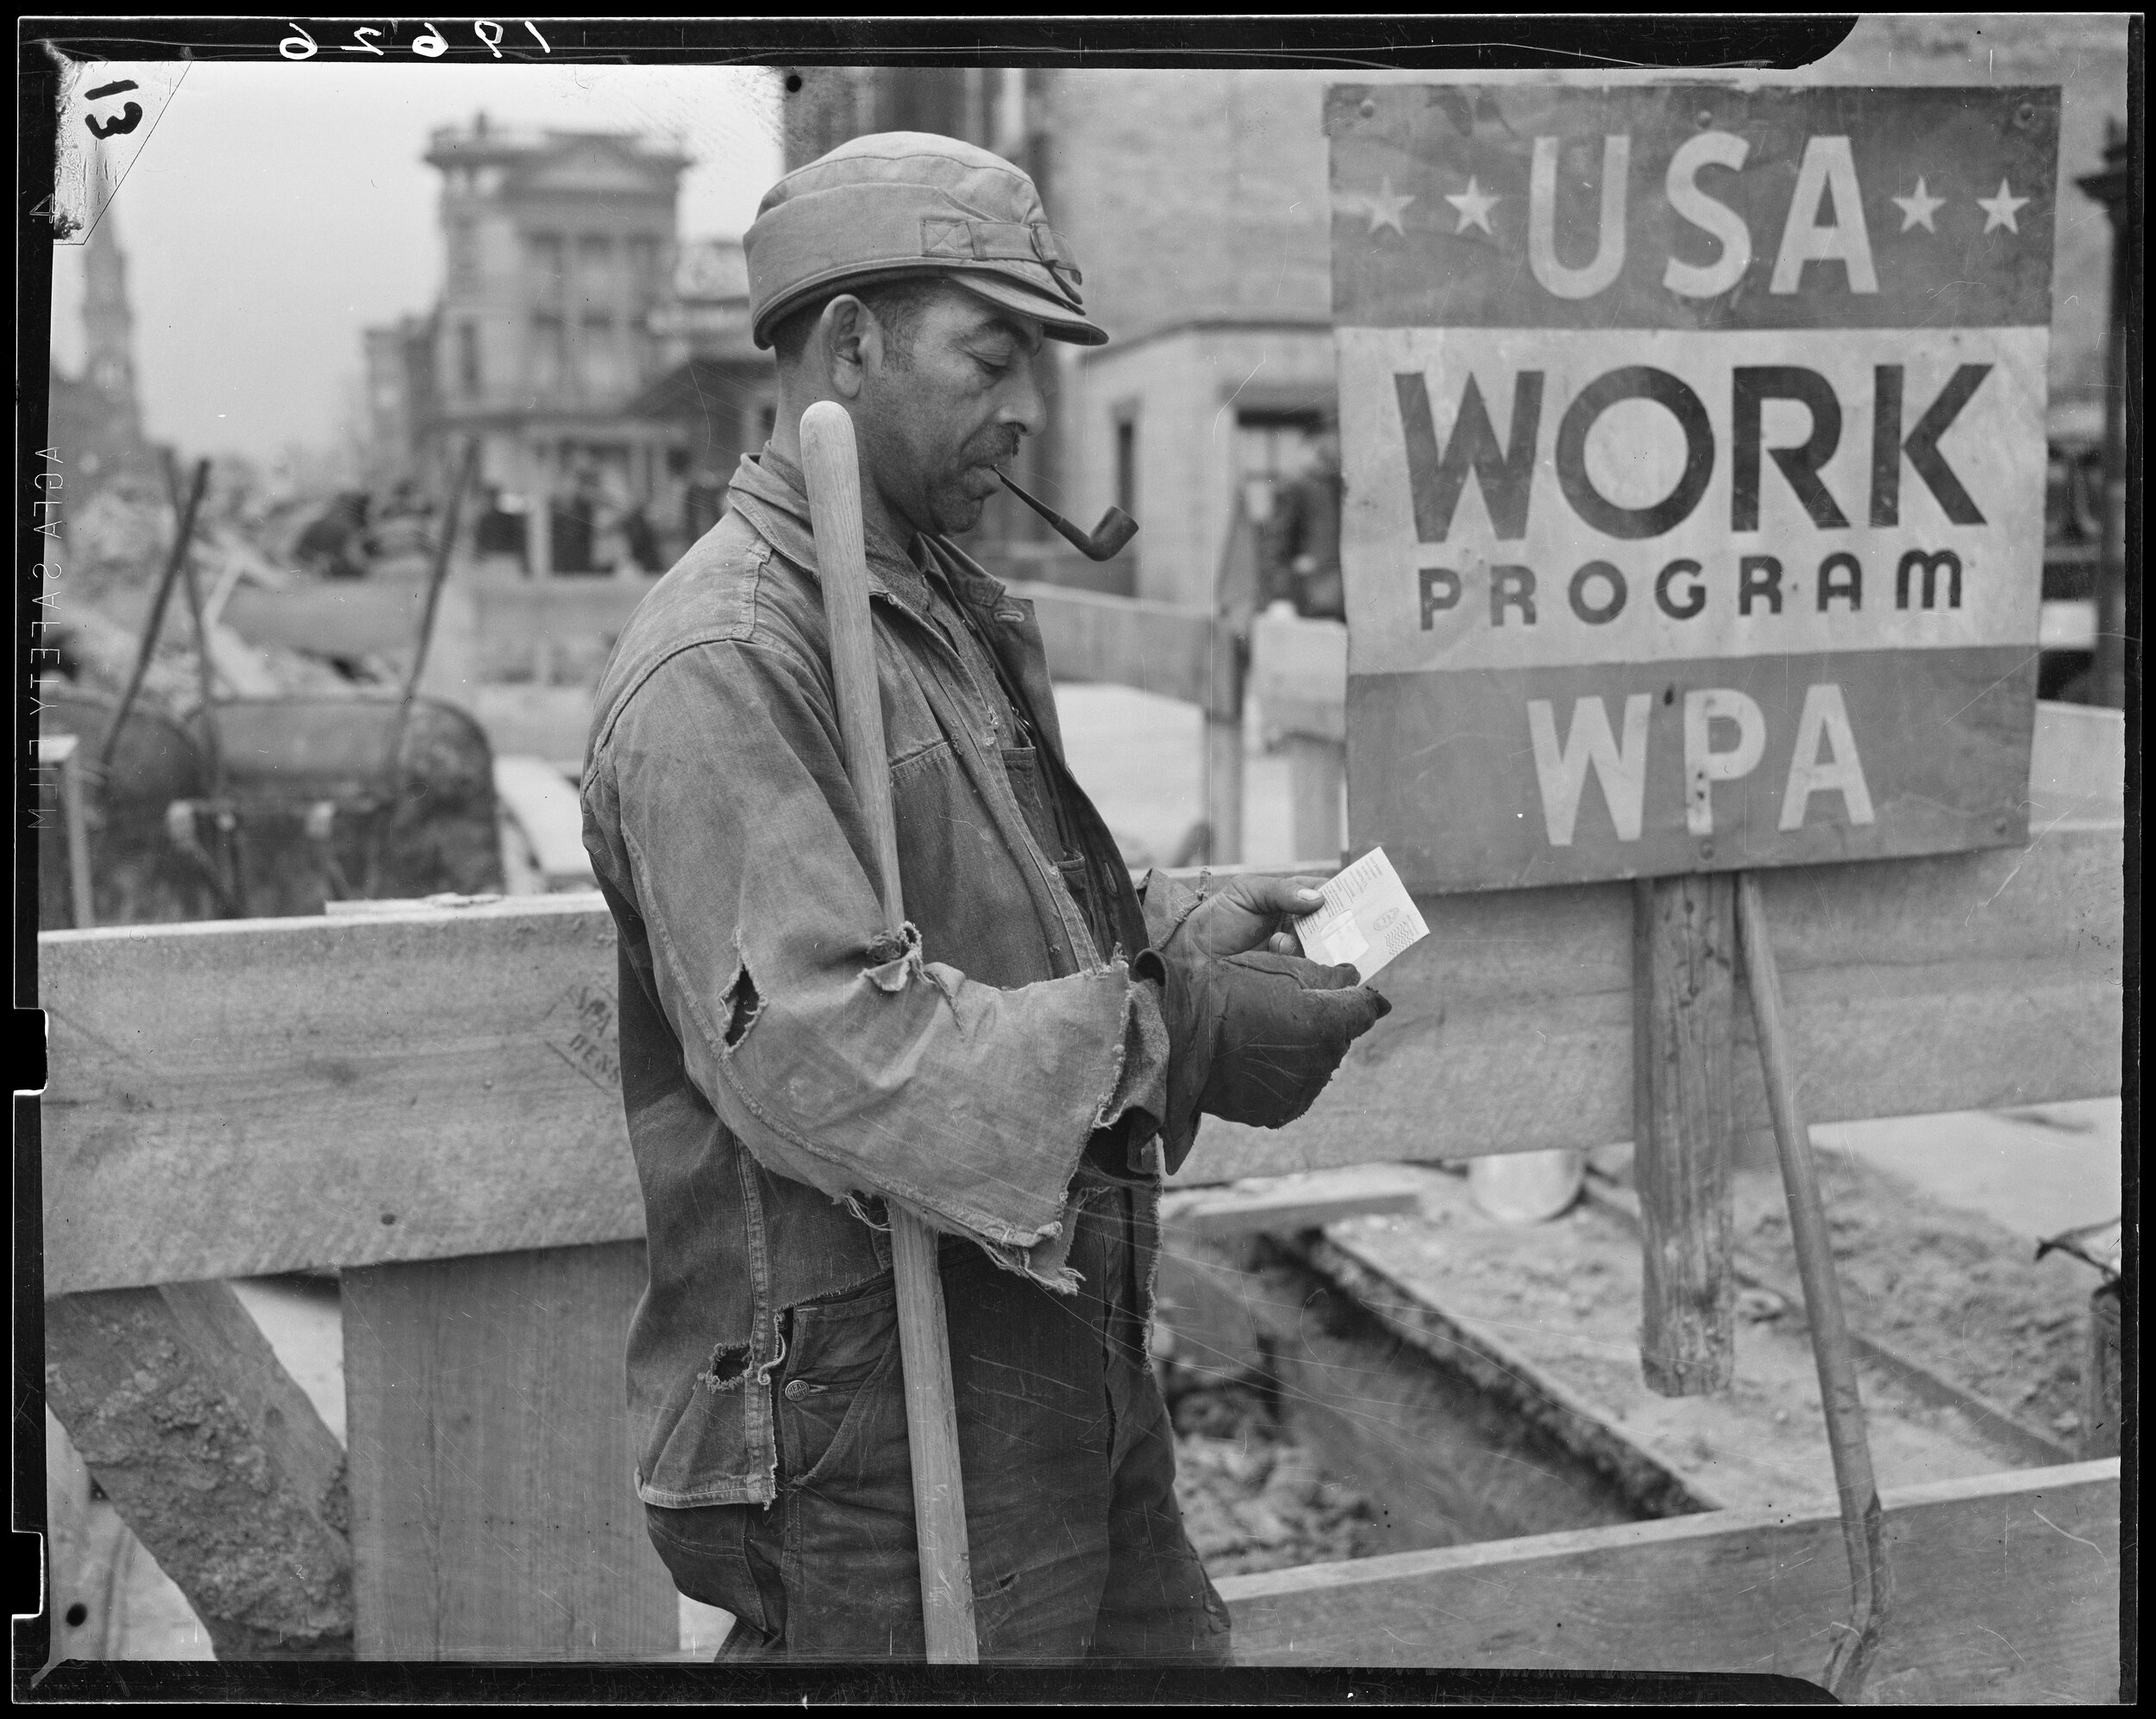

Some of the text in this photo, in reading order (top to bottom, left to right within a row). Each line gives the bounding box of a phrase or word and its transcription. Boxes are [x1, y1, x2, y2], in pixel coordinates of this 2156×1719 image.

[85, 79, 142, 140] 13
[29, 192, 60, 223] 4
[1527, 131, 1879, 299] USA
[1394, 363, 1996, 543] WORK
[1419, 549, 1962, 631] PROGRAM
[1526, 682, 1875, 847] WPA
[788, 1383, 806, 1394] HEAD
